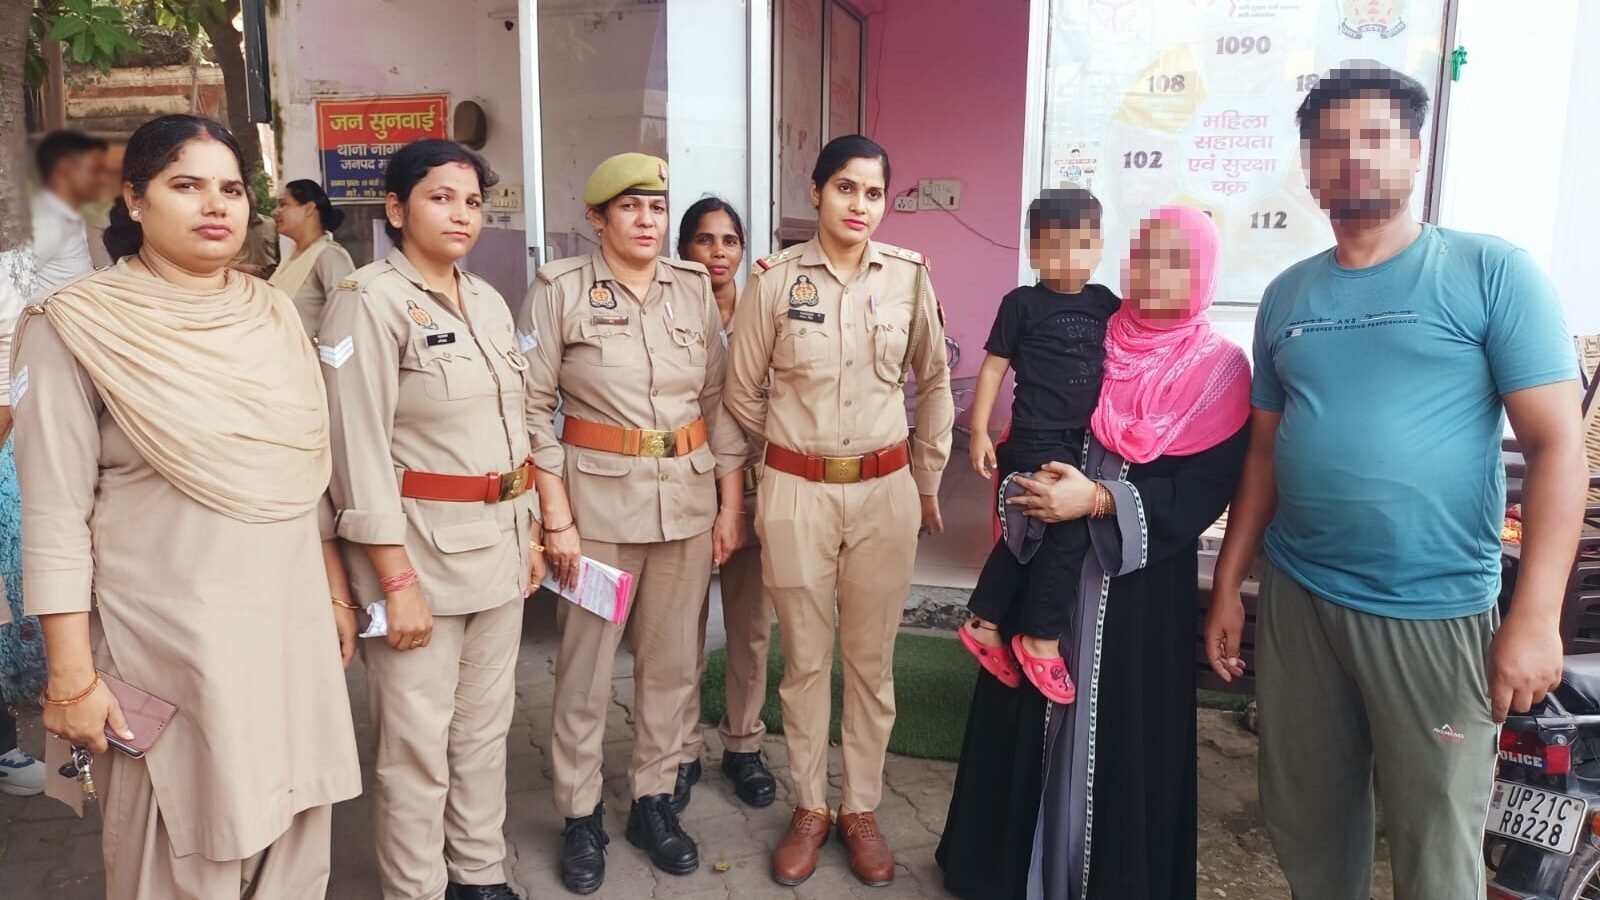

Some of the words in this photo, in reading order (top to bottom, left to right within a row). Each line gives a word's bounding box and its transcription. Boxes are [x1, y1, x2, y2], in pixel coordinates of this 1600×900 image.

[1216, 36, 1271, 55] 1090
[1148, 74, 1185, 93] 108
[1296, 73, 1320, 92] 18
[328, 114, 363, 131] जन
[369, 105, 436, 140] सुनवाई
[1203, 110, 1268, 131] महिला
[337, 143, 367, 157] थाना
[1194, 135, 1275, 150] सहायता
[340, 159, 375, 170] जनपद
[1123, 151, 1163, 169] 102
[1187, 154, 1217, 172] एवं
[1222, 158, 1278, 178] सुरक्षा
[1211, 181, 1248, 196] चक्र
[1250, 211, 1287, 229] 112
[1367, 318, 1418, 327] PERFORMANCE
[1500, 751, 1542, 767] OLICE
[1507, 786, 1572, 821] UP21C
[1499, 811, 1563, 847] R8228
